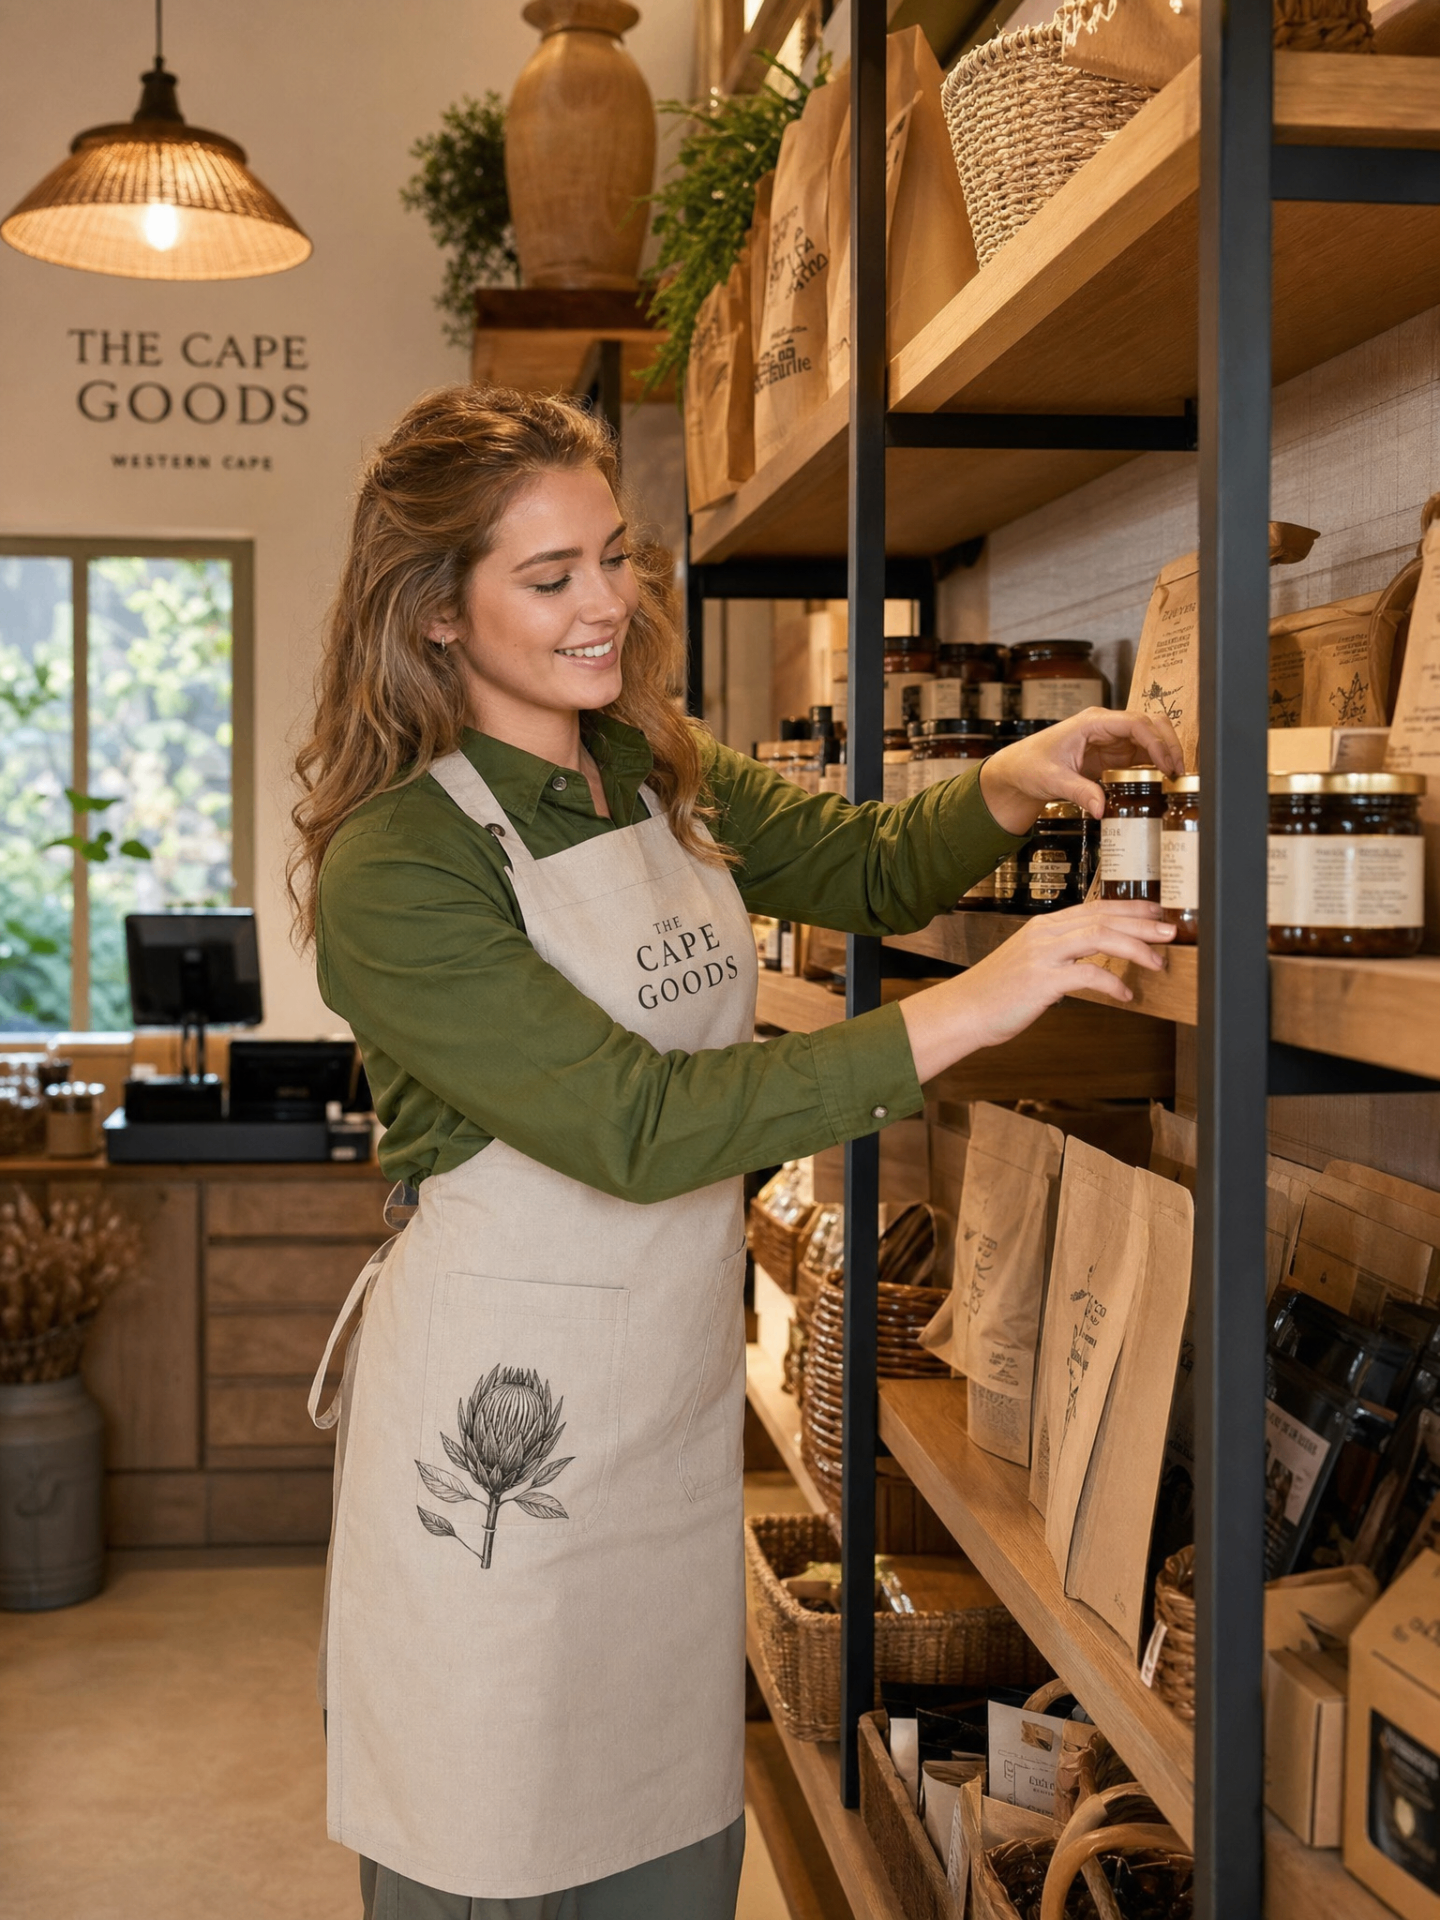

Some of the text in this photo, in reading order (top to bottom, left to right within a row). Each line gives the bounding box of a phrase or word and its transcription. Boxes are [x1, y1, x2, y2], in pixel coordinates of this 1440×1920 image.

[67, 328, 309, 370] THE CAPE
[76, 379, 310, 427] GOODS
[111, 454, 274, 471] WESTERN CAPE
[636, 923, 720, 971] CAPE
[653, 916, 682, 934] THE
[638, 955, 738, 1010] GOODS
